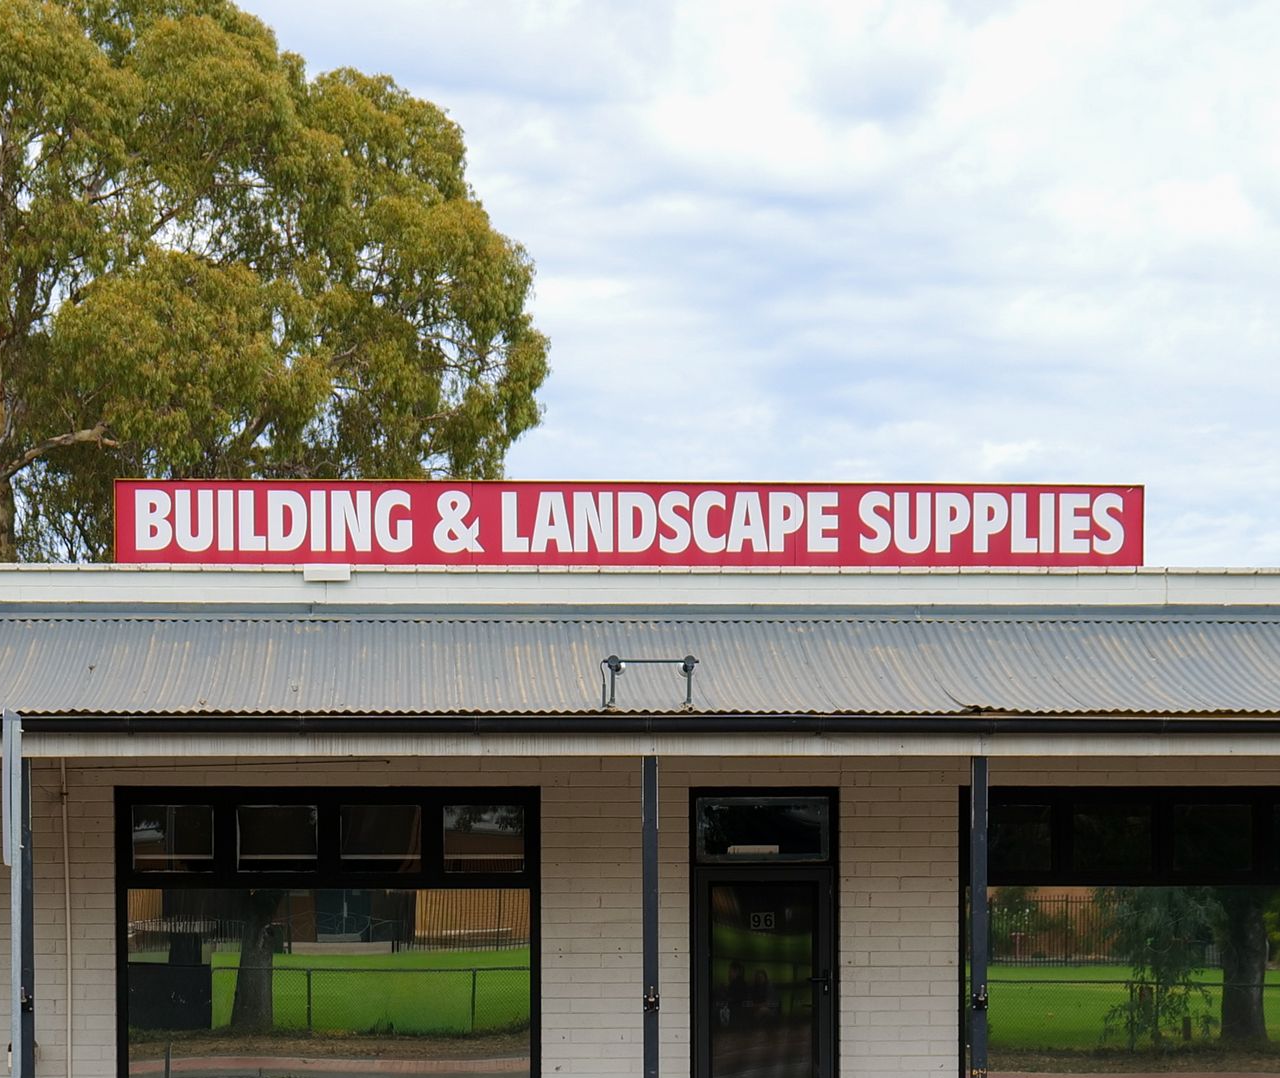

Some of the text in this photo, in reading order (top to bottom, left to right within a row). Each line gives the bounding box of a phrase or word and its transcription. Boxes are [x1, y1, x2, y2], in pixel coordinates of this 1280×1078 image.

[133, 488, 1126, 556] BUILDING & LANDSCAPE SUPPLIES
[752, 914, 772, 928] 96
